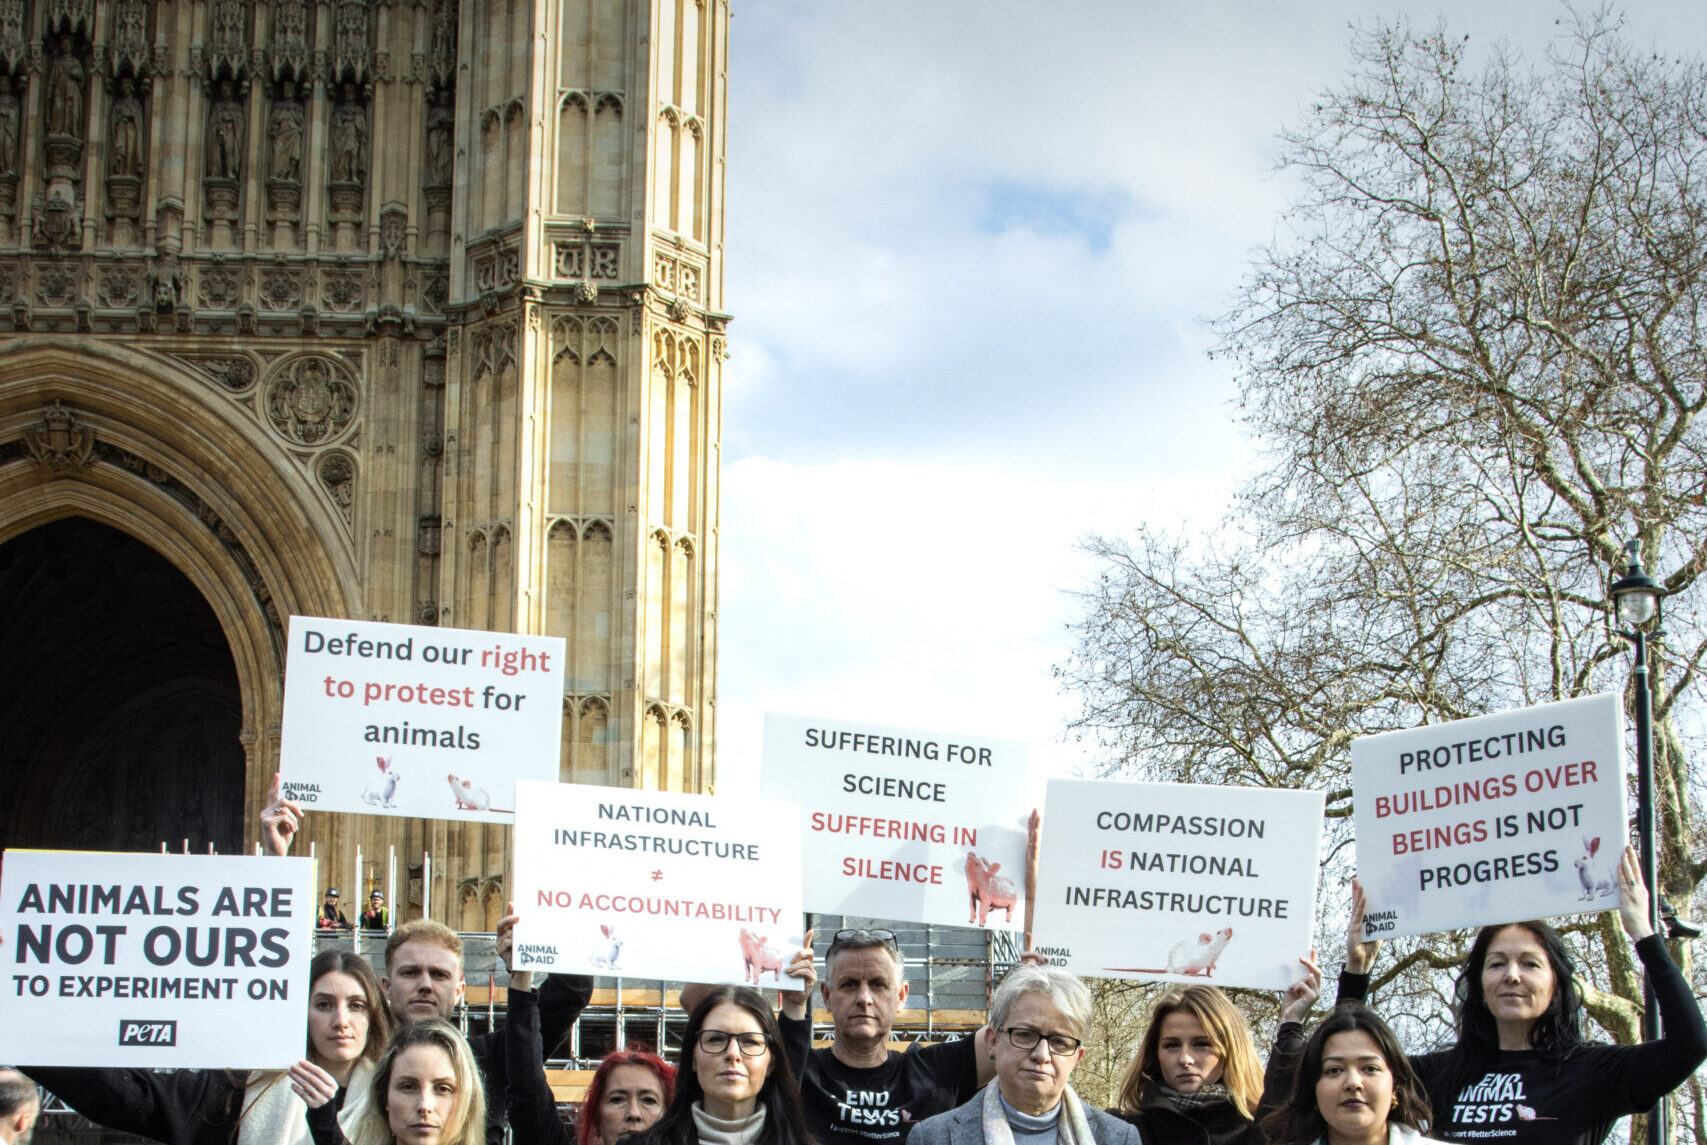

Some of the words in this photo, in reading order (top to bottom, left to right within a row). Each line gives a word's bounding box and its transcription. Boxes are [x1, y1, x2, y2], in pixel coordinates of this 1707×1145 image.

[304, 631, 412, 660] Defend
[423, 646, 472, 665] our
[482, 645, 550, 675] right
[324, 676, 354, 698] to
[365, 683, 474, 707] protest
[482, 686, 525, 711] for
[364, 721, 480, 750] animals
[806, 728, 938, 760] SUFFERING
[947, 744, 991, 766] FOR
[1400, 725, 1565, 774] PROTECTING
[282, 782, 322, 795] ANIMAL
[299, 793, 317, 802] AID
[843, 774, 945, 802] SCIENCE
[1376, 775, 1517, 818] BUILDINGS
[1525, 761, 1597, 792] OVER
[599, 804, 716, 828] NATIONAL
[812, 812, 945, 843] SUFFERING
[954, 827, 976, 846] IN
[1097, 812, 1264, 838] COMPASSION
[1393, 820, 1487, 855] BEINGS
[1496, 815, 1519, 838] IS
[1527, 804, 1583, 833] NOT
[555, 829, 759, 860] INFRASTRUCTURE
[843, 858, 942, 884] SILENCE
[1102, 850, 1122, 869] IS
[1131, 852, 1258, 877] NATIONAL
[1420, 850, 1559, 891] PROGRESS
[17, 884, 199, 915] ANIMALS
[212, 887, 292, 917] ARE
[538, 890, 571, 907] NO
[579, 894, 781, 924] ACCOUNTABILITY
[1066, 887, 1288, 918] INFRASTRUCTURE
[1363, 911, 1398, 922] ANIMAL
[1378, 922, 1395, 932] AID
[16, 924, 126, 964] NOT
[143, 926, 289, 968] OURS
[517, 943, 559, 956] ANIMAL
[1035, 947, 1071, 957] ANIMAL
[535, 956, 554, 964] AID
[1050, 958, 1067, 967] AID
[13, 975, 49, 996] TO
[59, 976, 238, 999] EXPERIMENT
[247, 979, 288, 1000] ON
[846, 1090, 889, 1106] END
[1453, 1103, 1513, 1123] TESTS
[1468, 1129, 1516, 1137] #BetterScience
